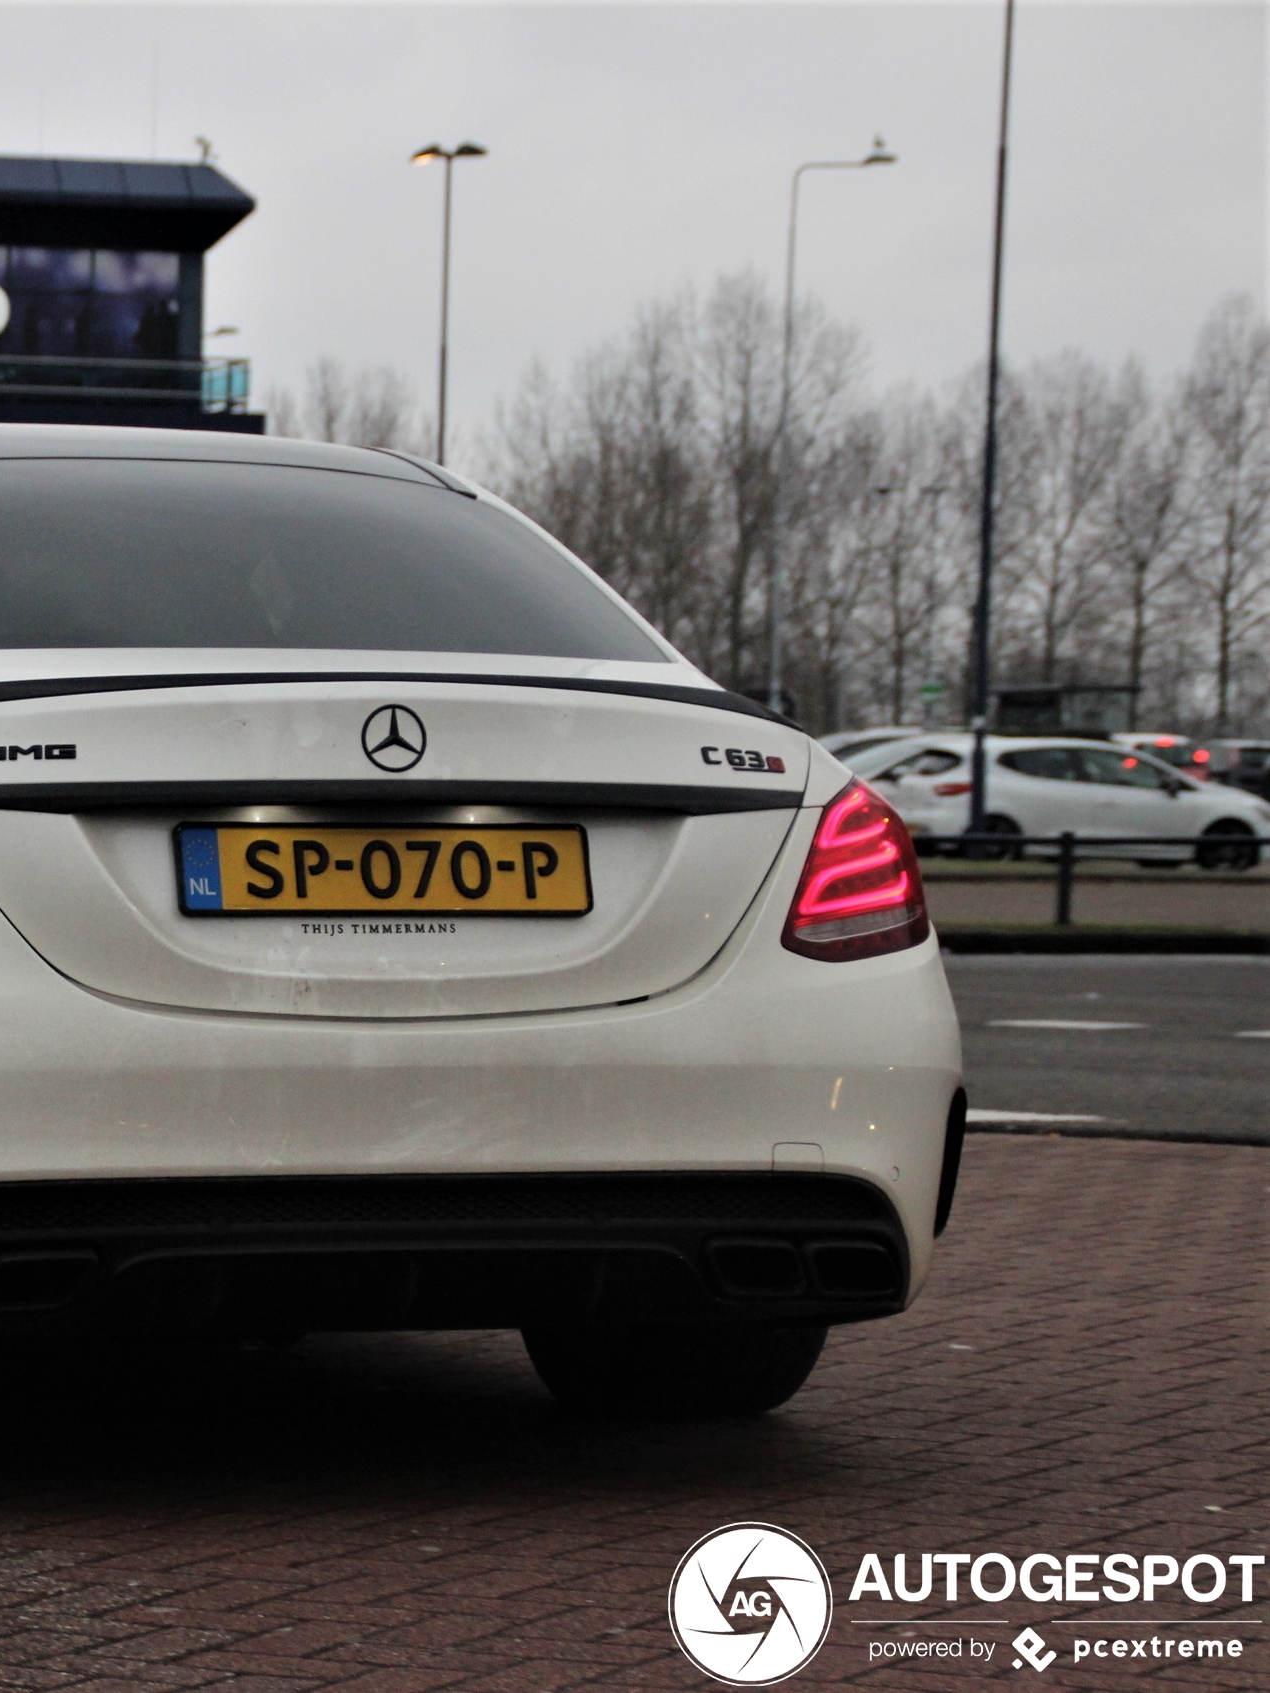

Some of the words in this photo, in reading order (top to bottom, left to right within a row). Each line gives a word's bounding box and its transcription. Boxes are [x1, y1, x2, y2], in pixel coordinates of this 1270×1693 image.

[701, 746, 722, 765] C
[245, 840, 559, 899] SP-070-P
[190, 878, 216, 896] NL
[302, 924, 345, 937] THIJS
[351, 924, 457, 934] TIMMERMANS
